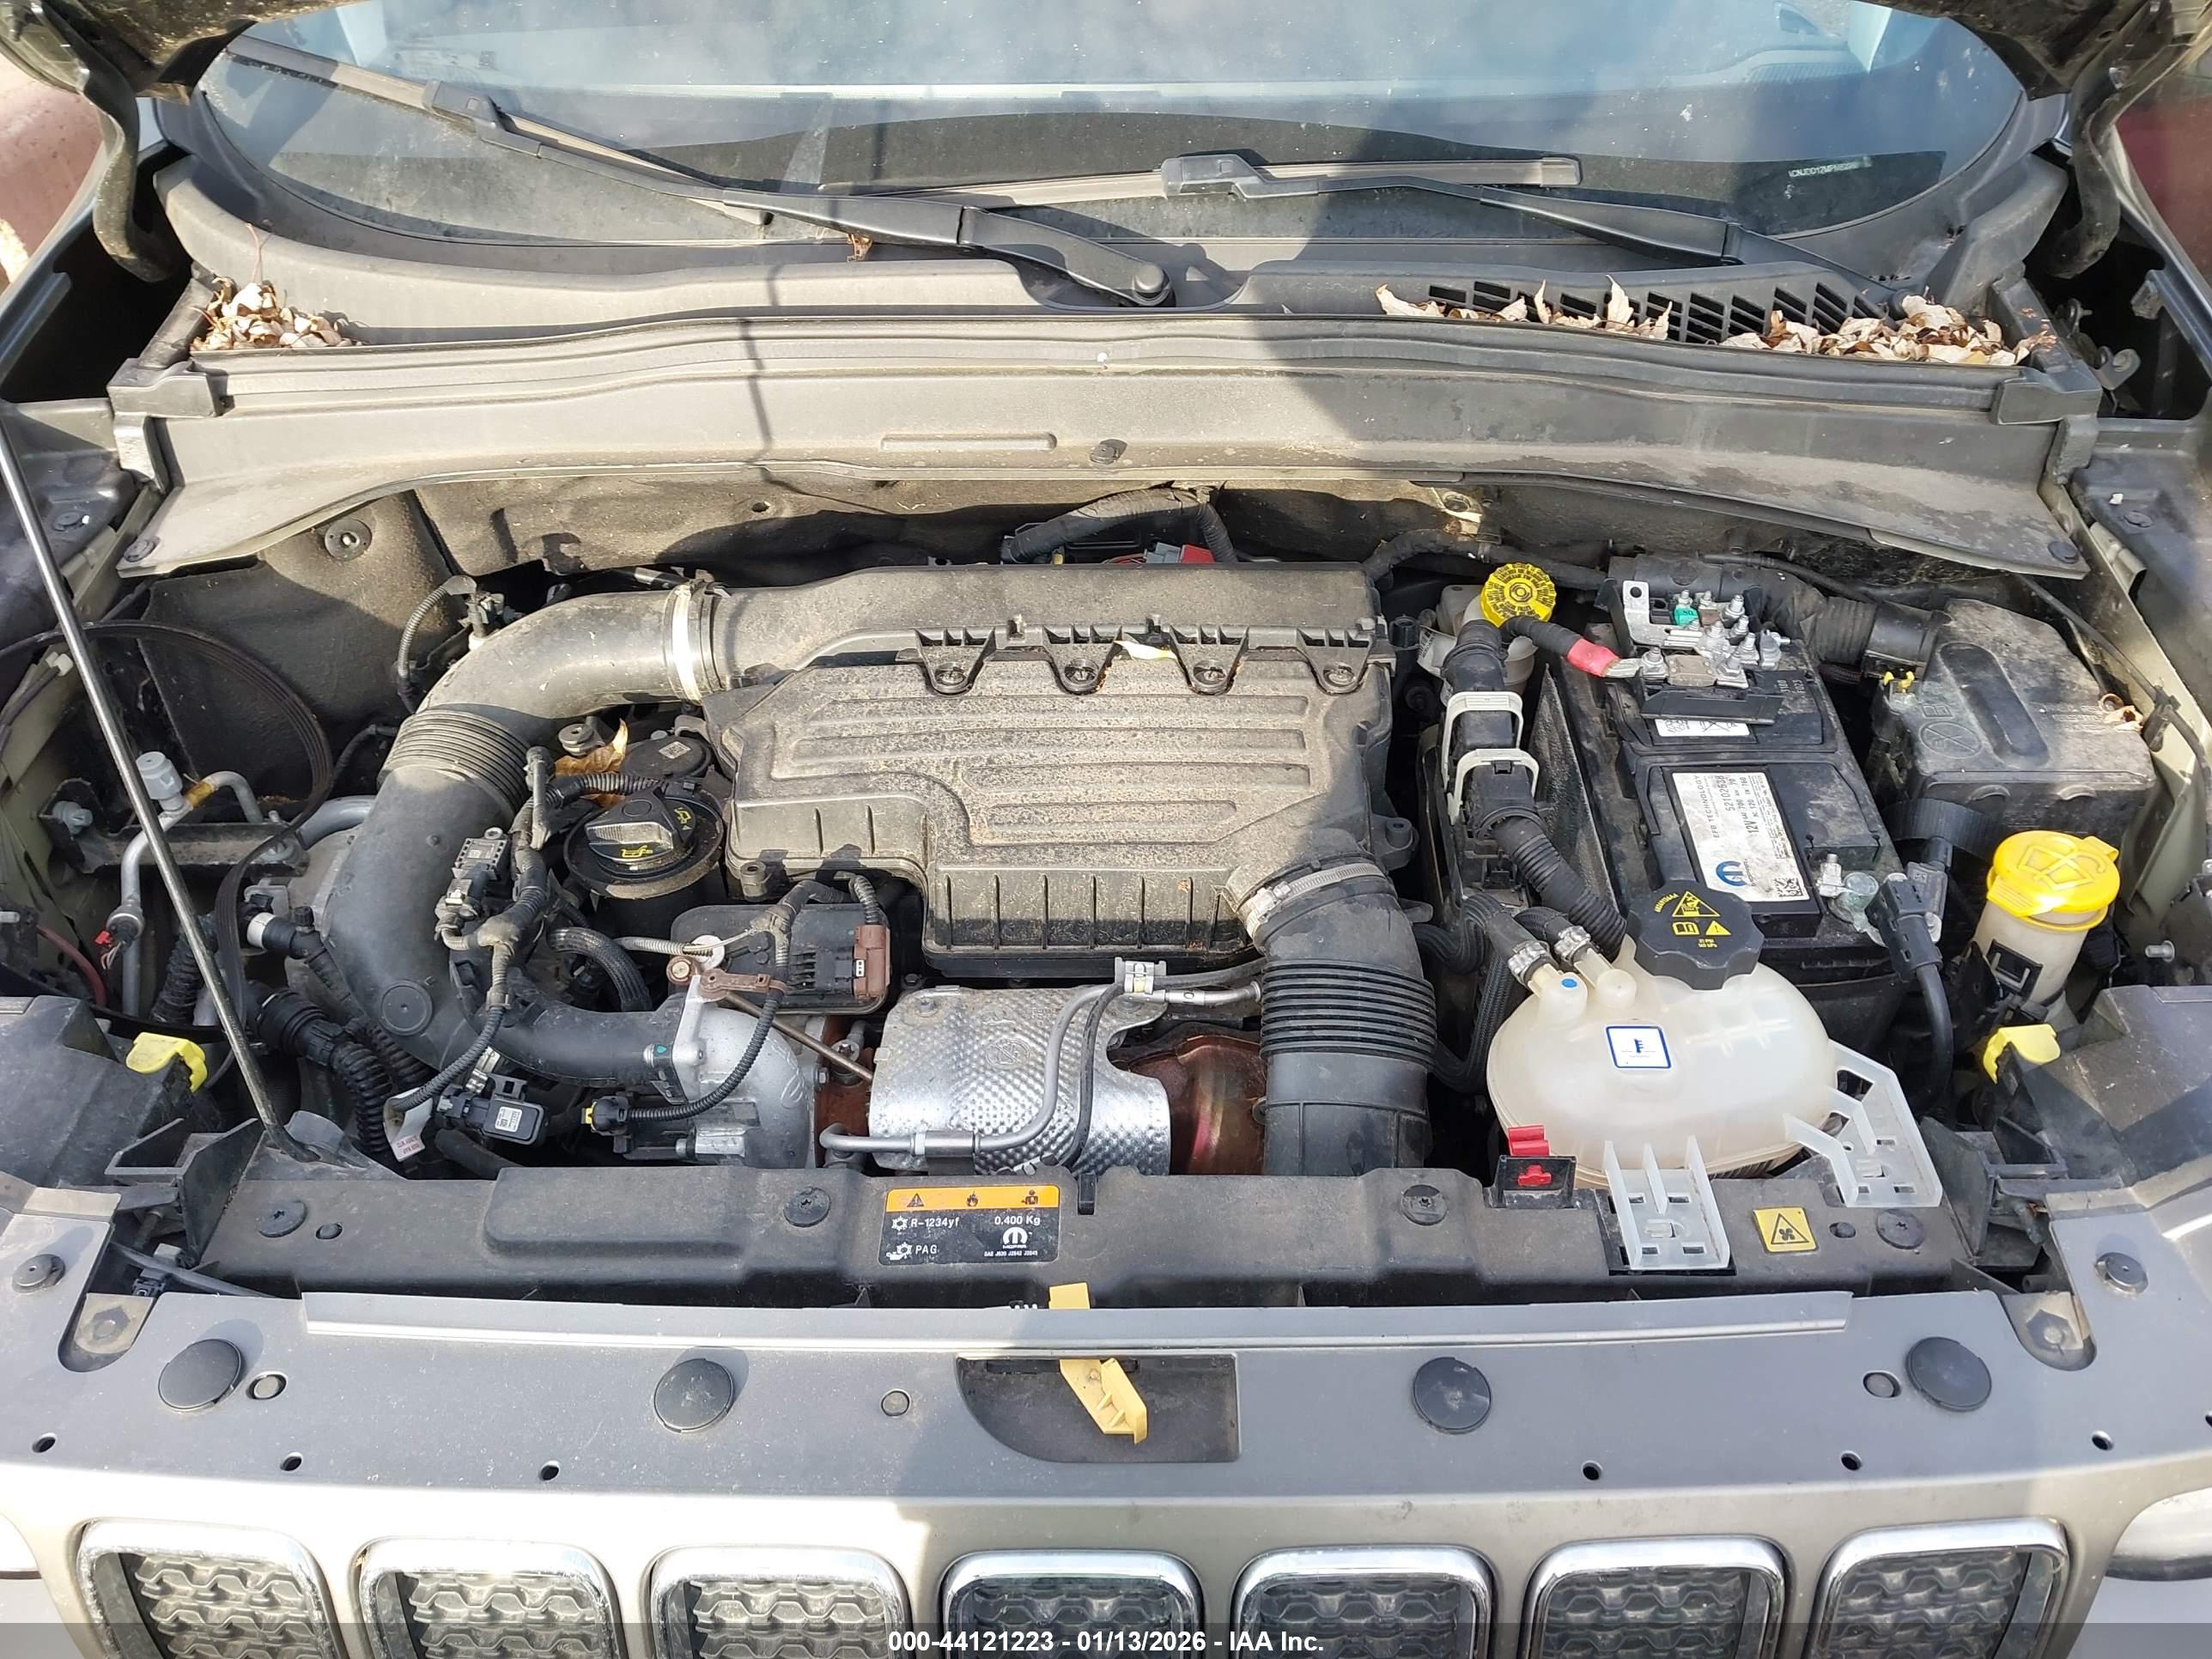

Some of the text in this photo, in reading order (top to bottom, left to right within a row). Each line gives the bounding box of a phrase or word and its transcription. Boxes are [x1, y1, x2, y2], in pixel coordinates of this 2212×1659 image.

[1694, 775, 1716, 822] TECHNOLOGY
[911, 1215, 1041, 1229] R-1234yf 0.400 Kg
[915, 1244, 938, 1255] PAG
